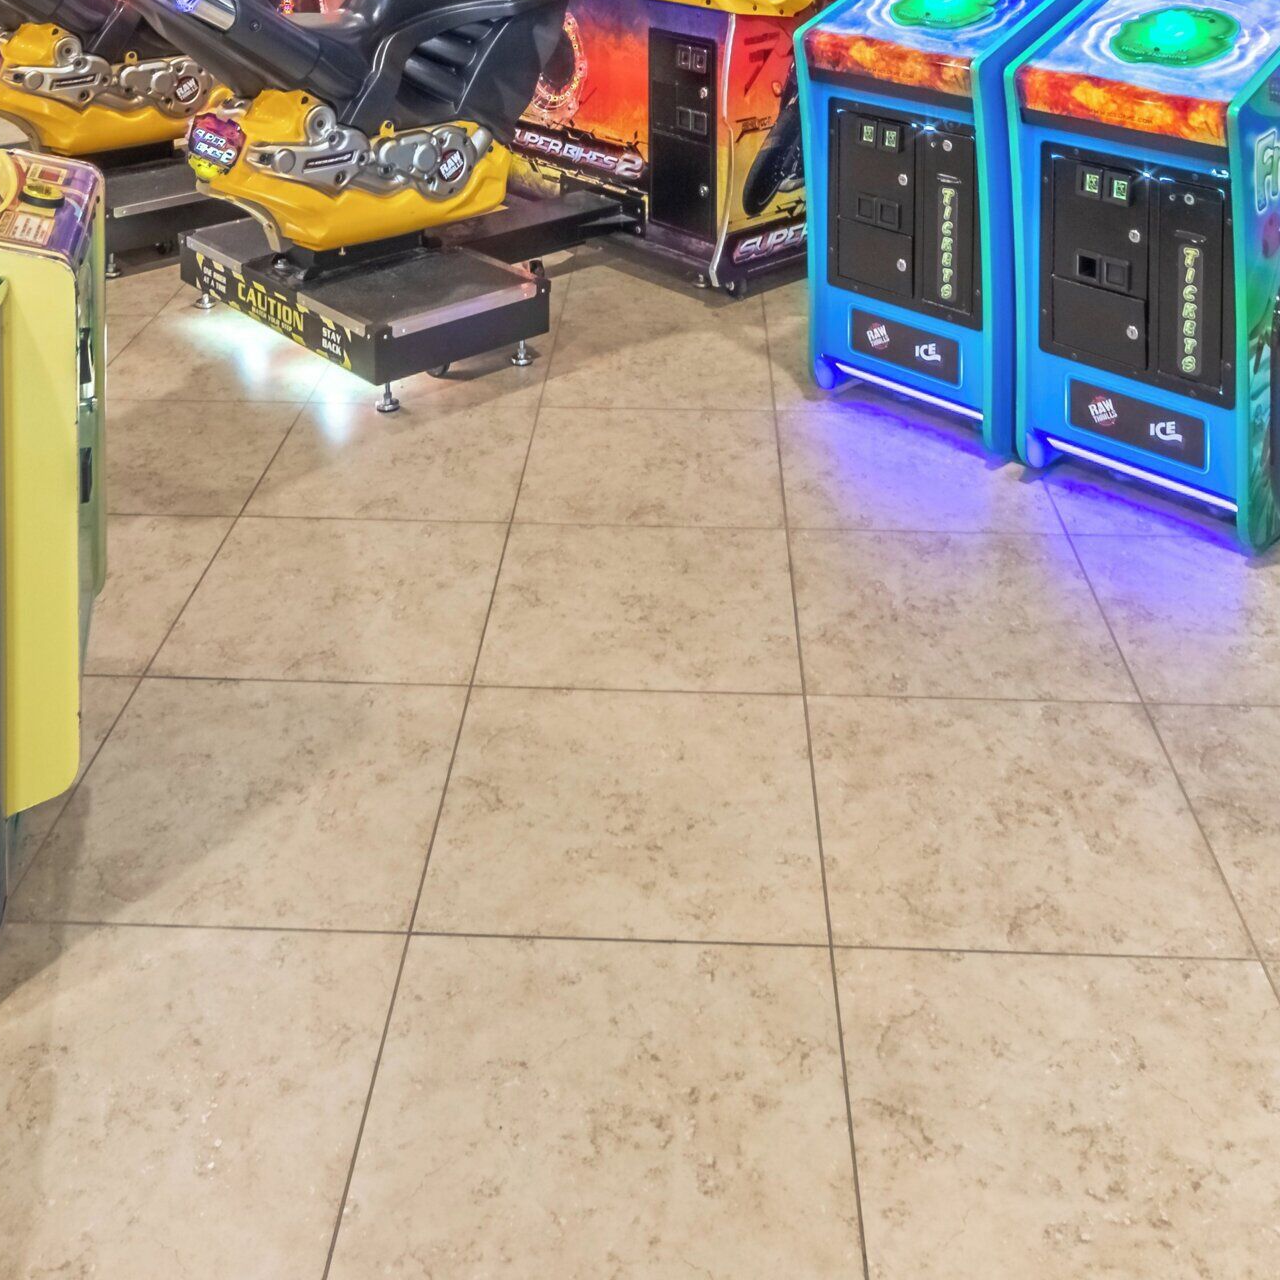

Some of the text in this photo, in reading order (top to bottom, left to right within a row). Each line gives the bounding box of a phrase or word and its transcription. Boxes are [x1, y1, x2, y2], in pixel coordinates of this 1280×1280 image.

[176, 77, 197, 96] RAW
[439, 151, 461, 175] RAW
[564, 142, 619, 169] BIKES
[615, 154, 644, 179] 2
[940, 187, 956, 300] TICKETS
[237, 282, 304, 332] CAUTION
[1181, 247, 1200, 373] TICKETS
[321, 326, 342, 344] STAY
[866, 325, 888, 341] RAW
[321, 340, 342, 356] BACK
[915, 343, 942, 361] ICE
[1088, 398, 1115, 416] RAW
[1149, 421, 1183, 442] ICE
